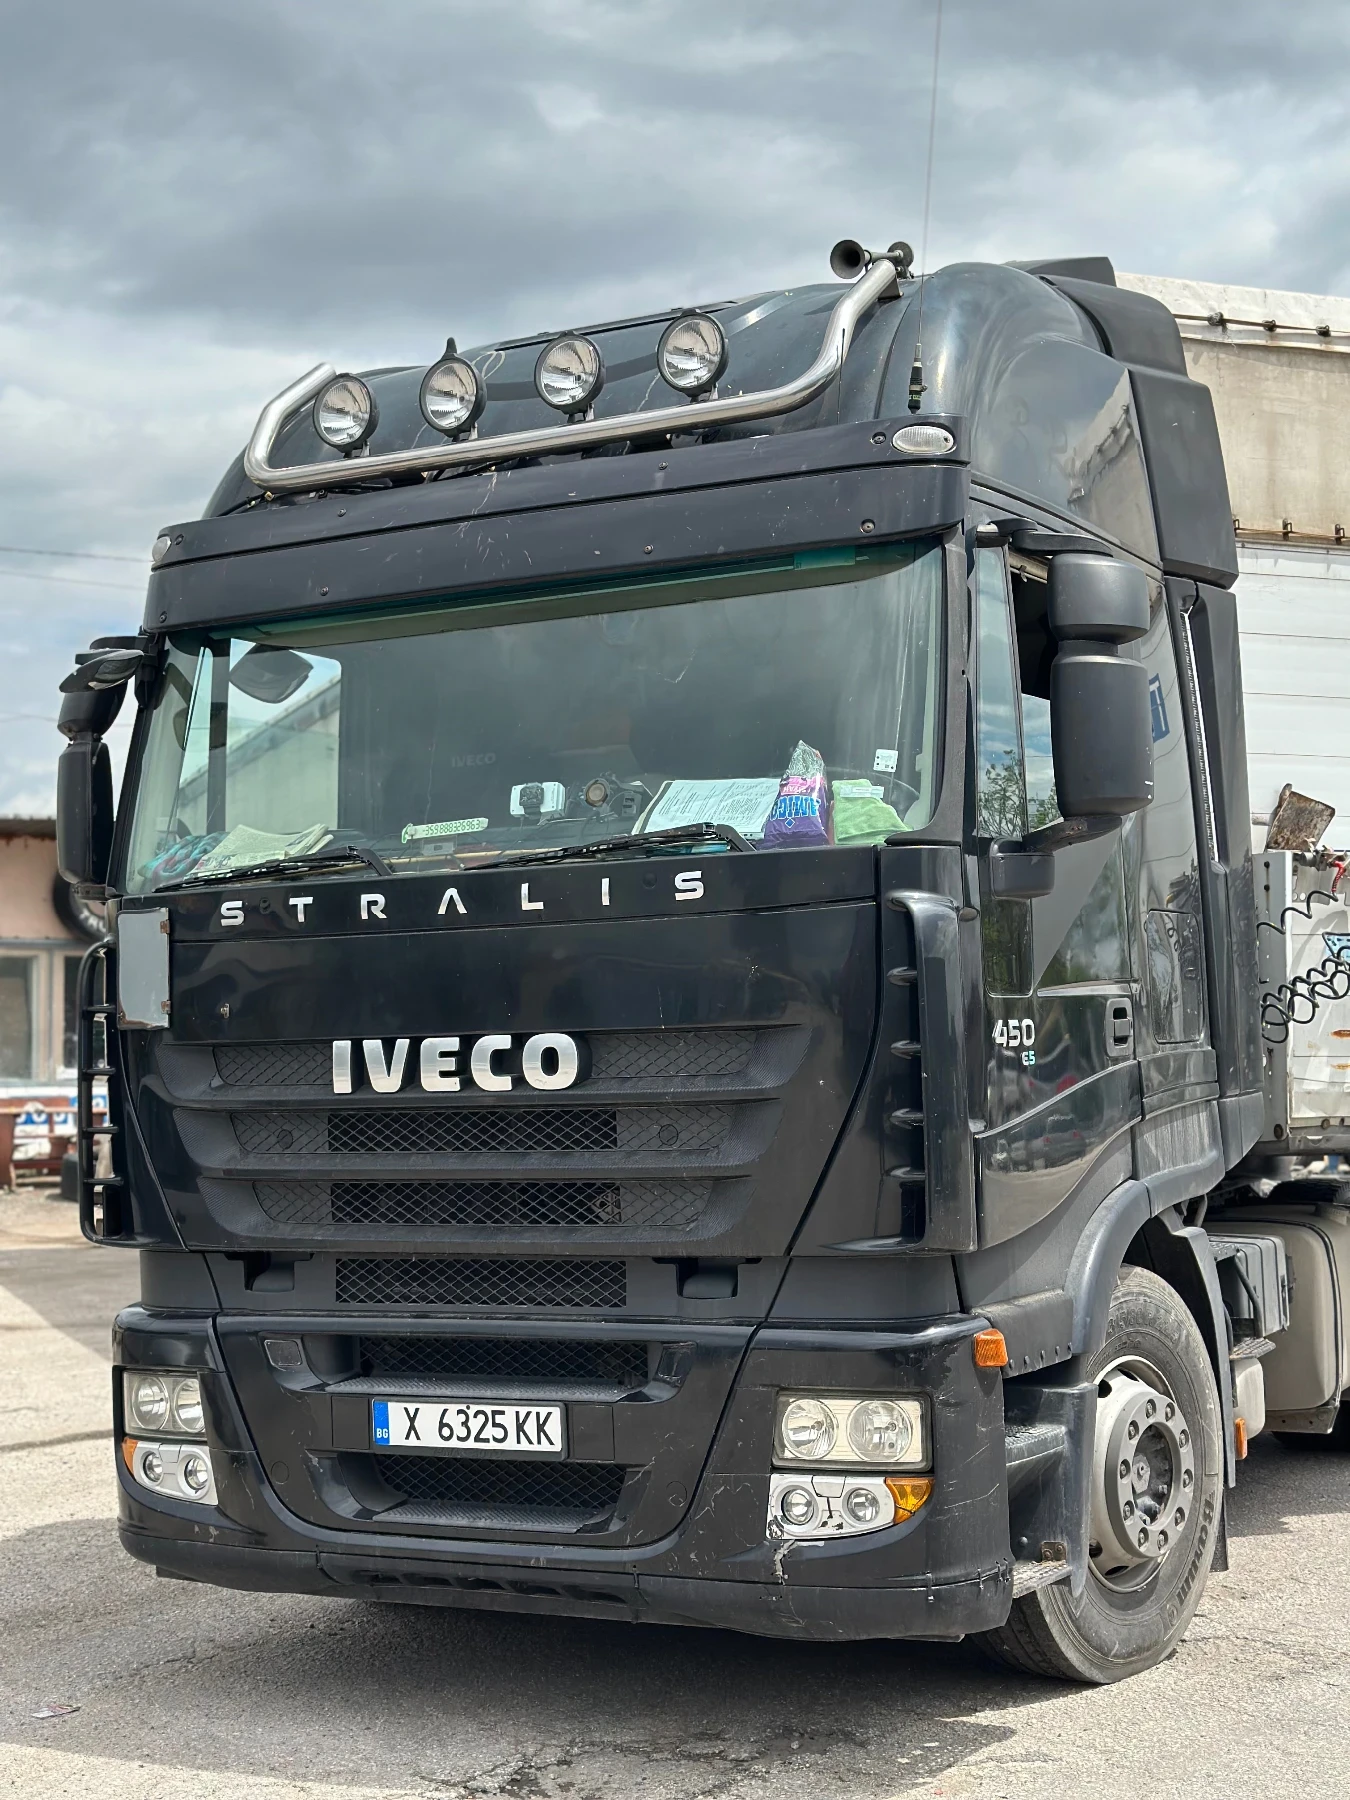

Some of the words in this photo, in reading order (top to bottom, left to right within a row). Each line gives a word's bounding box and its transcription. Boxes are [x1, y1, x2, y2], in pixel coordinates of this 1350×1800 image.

[220, 870, 705, 927] STRALIS
[992, 1018, 1035, 1047] 450
[332, 1032, 579, 1094] IVECO
[1021, 1050, 1036, 1066] E5
[376, 1427, 389, 1438] BG
[403, 1406, 422, 1441] X
